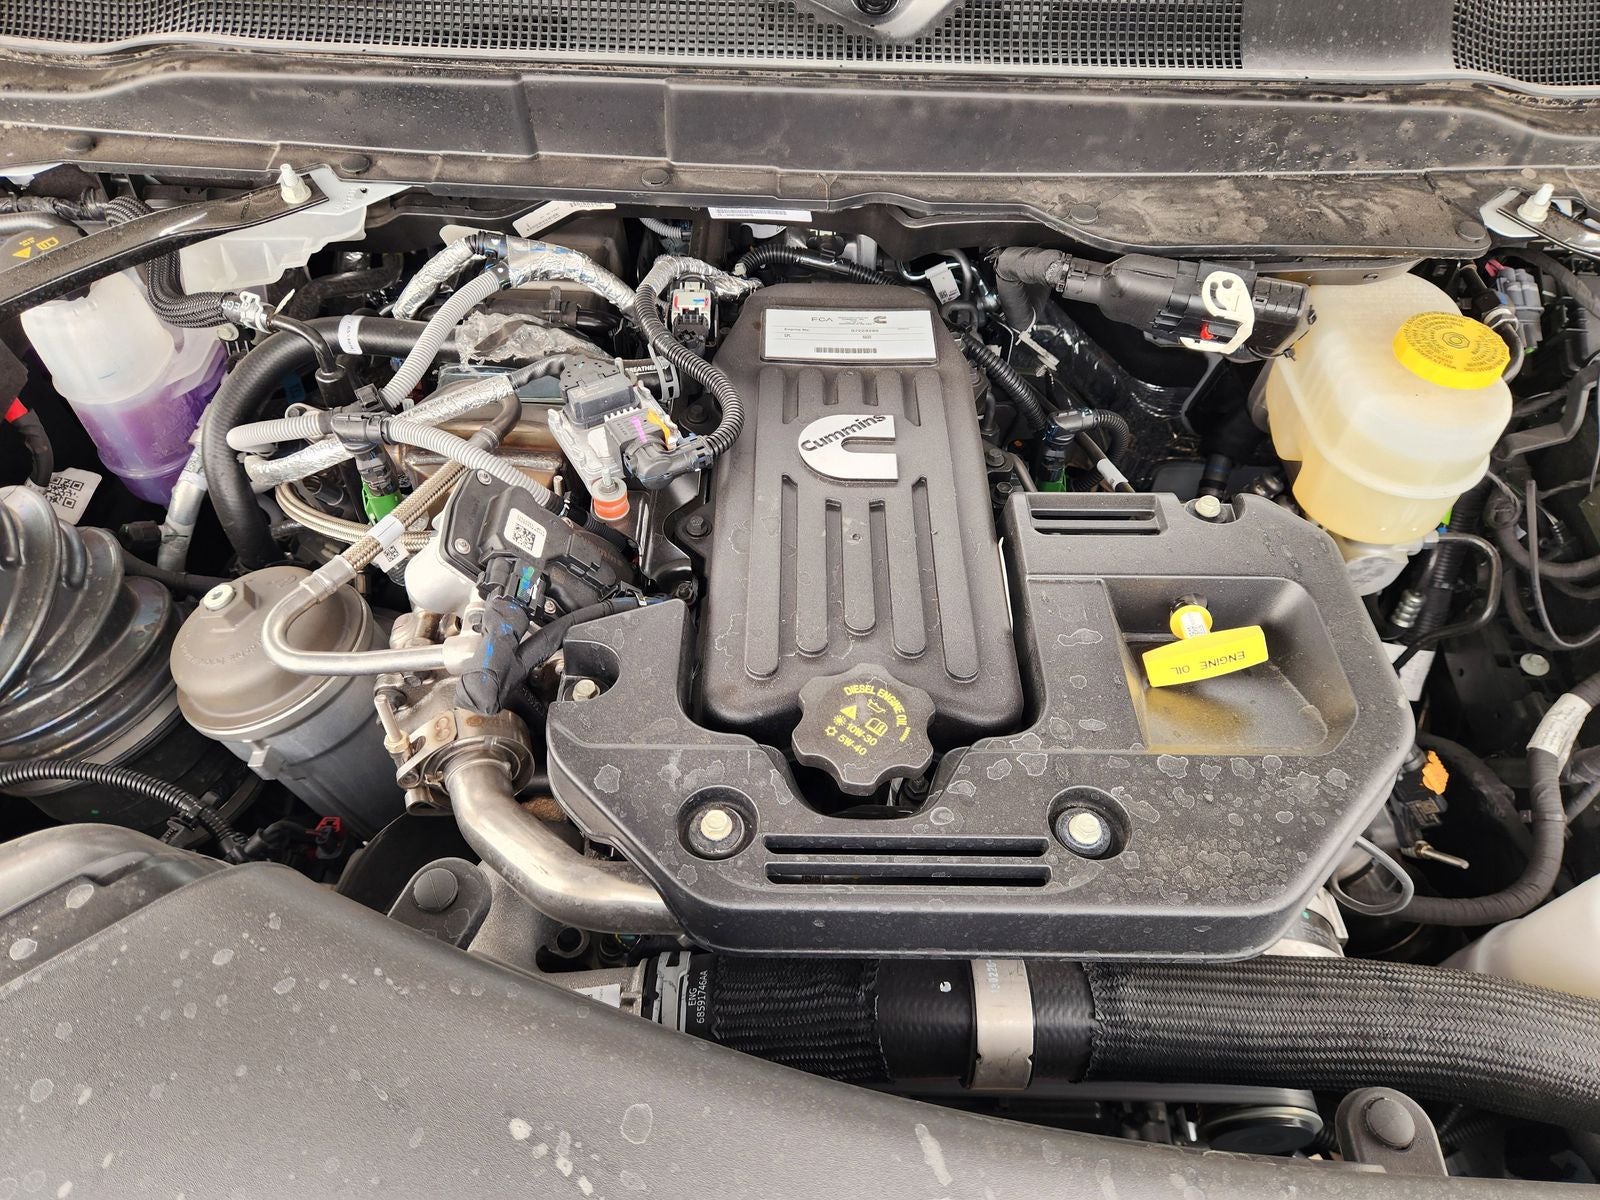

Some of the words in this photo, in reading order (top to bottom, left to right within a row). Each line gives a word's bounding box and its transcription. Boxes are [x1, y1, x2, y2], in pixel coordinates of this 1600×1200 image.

[801, 415, 886, 452] Cummins
[1170, 665, 1191, 675] OIL
[1200, 650, 1246, 670] ENGINE
[843, 684, 876, 696] DIESEL
[876, 688, 905, 714] ENGINE
[895, 714, 908, 728] OIL
[837, 733, 868, 756] 5W-40
[846, 722, 878, 747] 10W-30
[688, 987, 697, 1007] ENG
[696, 970, 708, 1024] 68591746AA
